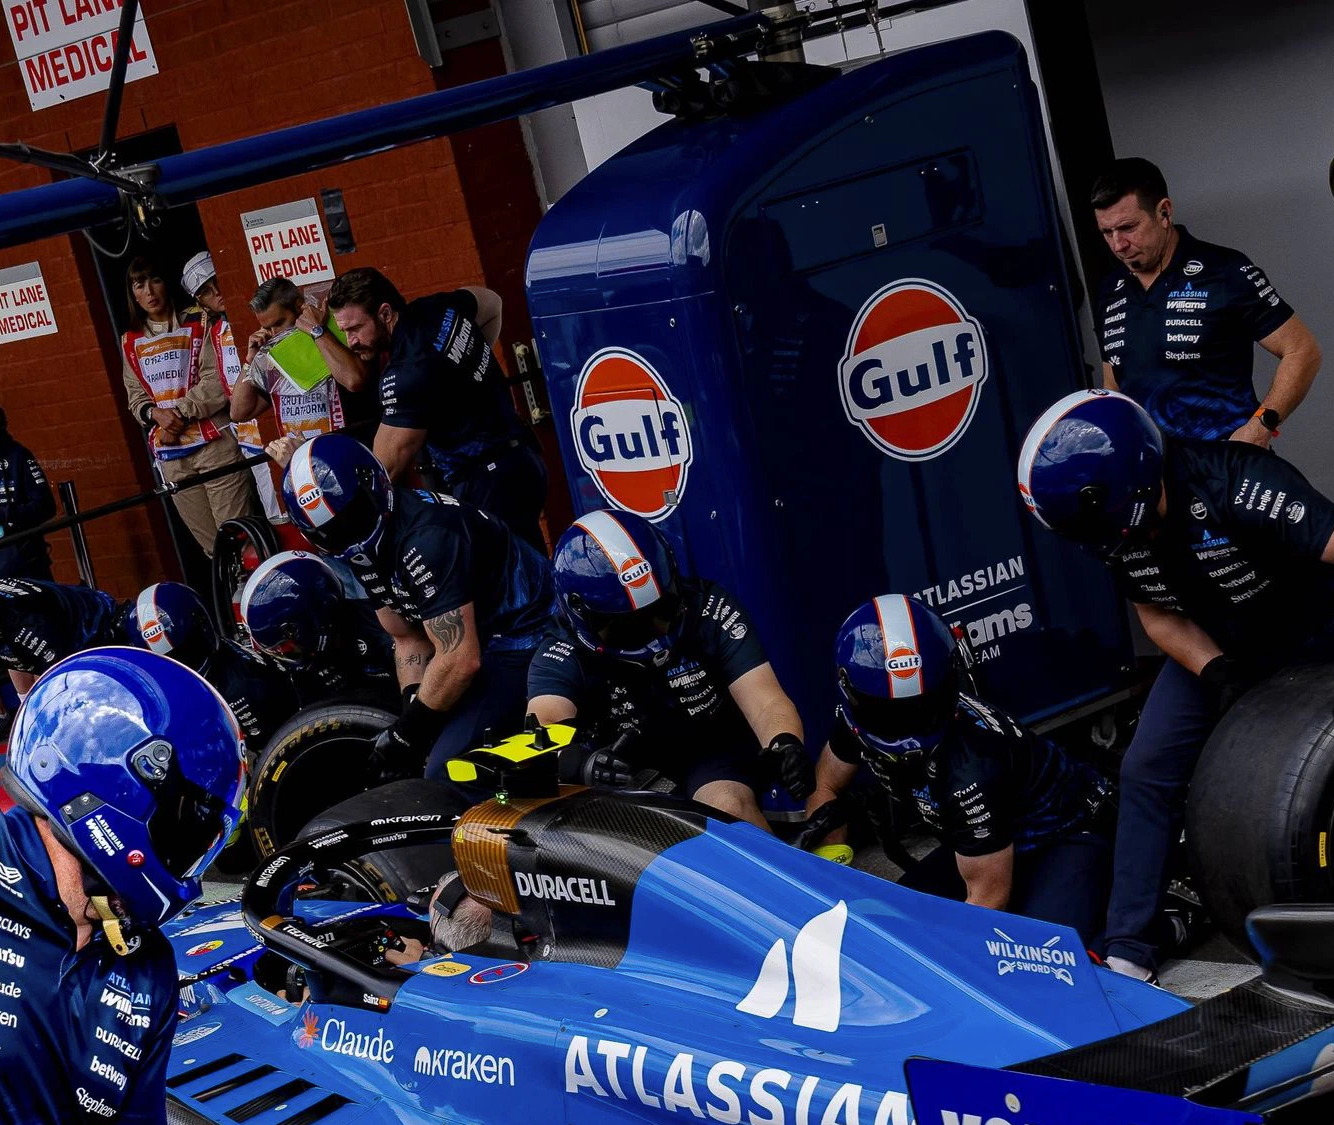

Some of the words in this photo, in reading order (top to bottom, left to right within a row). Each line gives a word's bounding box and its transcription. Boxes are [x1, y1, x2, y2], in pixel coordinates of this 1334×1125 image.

[10, 0, 50, 41] PIT
[251, 233, 273, 255] PIT
[278, 223, 320, 249] LANE
[259, 252, 328, 283] MEDICAL
[14, 284, 45, 307] LANE
[1167, 301, 1206, 309] Williams
[448, 318, 472, 364] Williams
[1167, 334, 1199, 343] betway
[1165, 351, 1200, 360] Stephens
[848, 331, 975, 409] Gulf
[579, 411, 681, 463] Gulf
[298, 488, 321, 507] Gulf
[1239, 478, 1250, 496] VAST
[622, 564, 649, 587] Gulf
[143, 626, 162, 639] Gulf
[888, 657, 920, 669] Gulf
[669, 670, 706, 688] Williams
[688, 694, 717, 716] betway
[384, 813, 441, 825] kraken
[85, 818, 116, 857] Williams
[97, 818, 125, 851] ATLASSIAN
[312, 833, 349, 849] Williams
[372, 832, 407, 845] KOMATSU
[261, 856, 291, 882] kraken
[515, 871, 616, 906] DURACELL
[985, 940, 1076, 968] WILKINSON
[1017, 962, 1051, 975] SWORD
[363, 994, 379, 1004] Sainz
[95, 1025, 142, 1062] DURACELL
[321, 1018, 394, 1064] Claude
[90, 1055, 128, 1091] betway
[432, 1046, 515, 1088] kraken
[75, 1087, 117, 1120] Stephens
